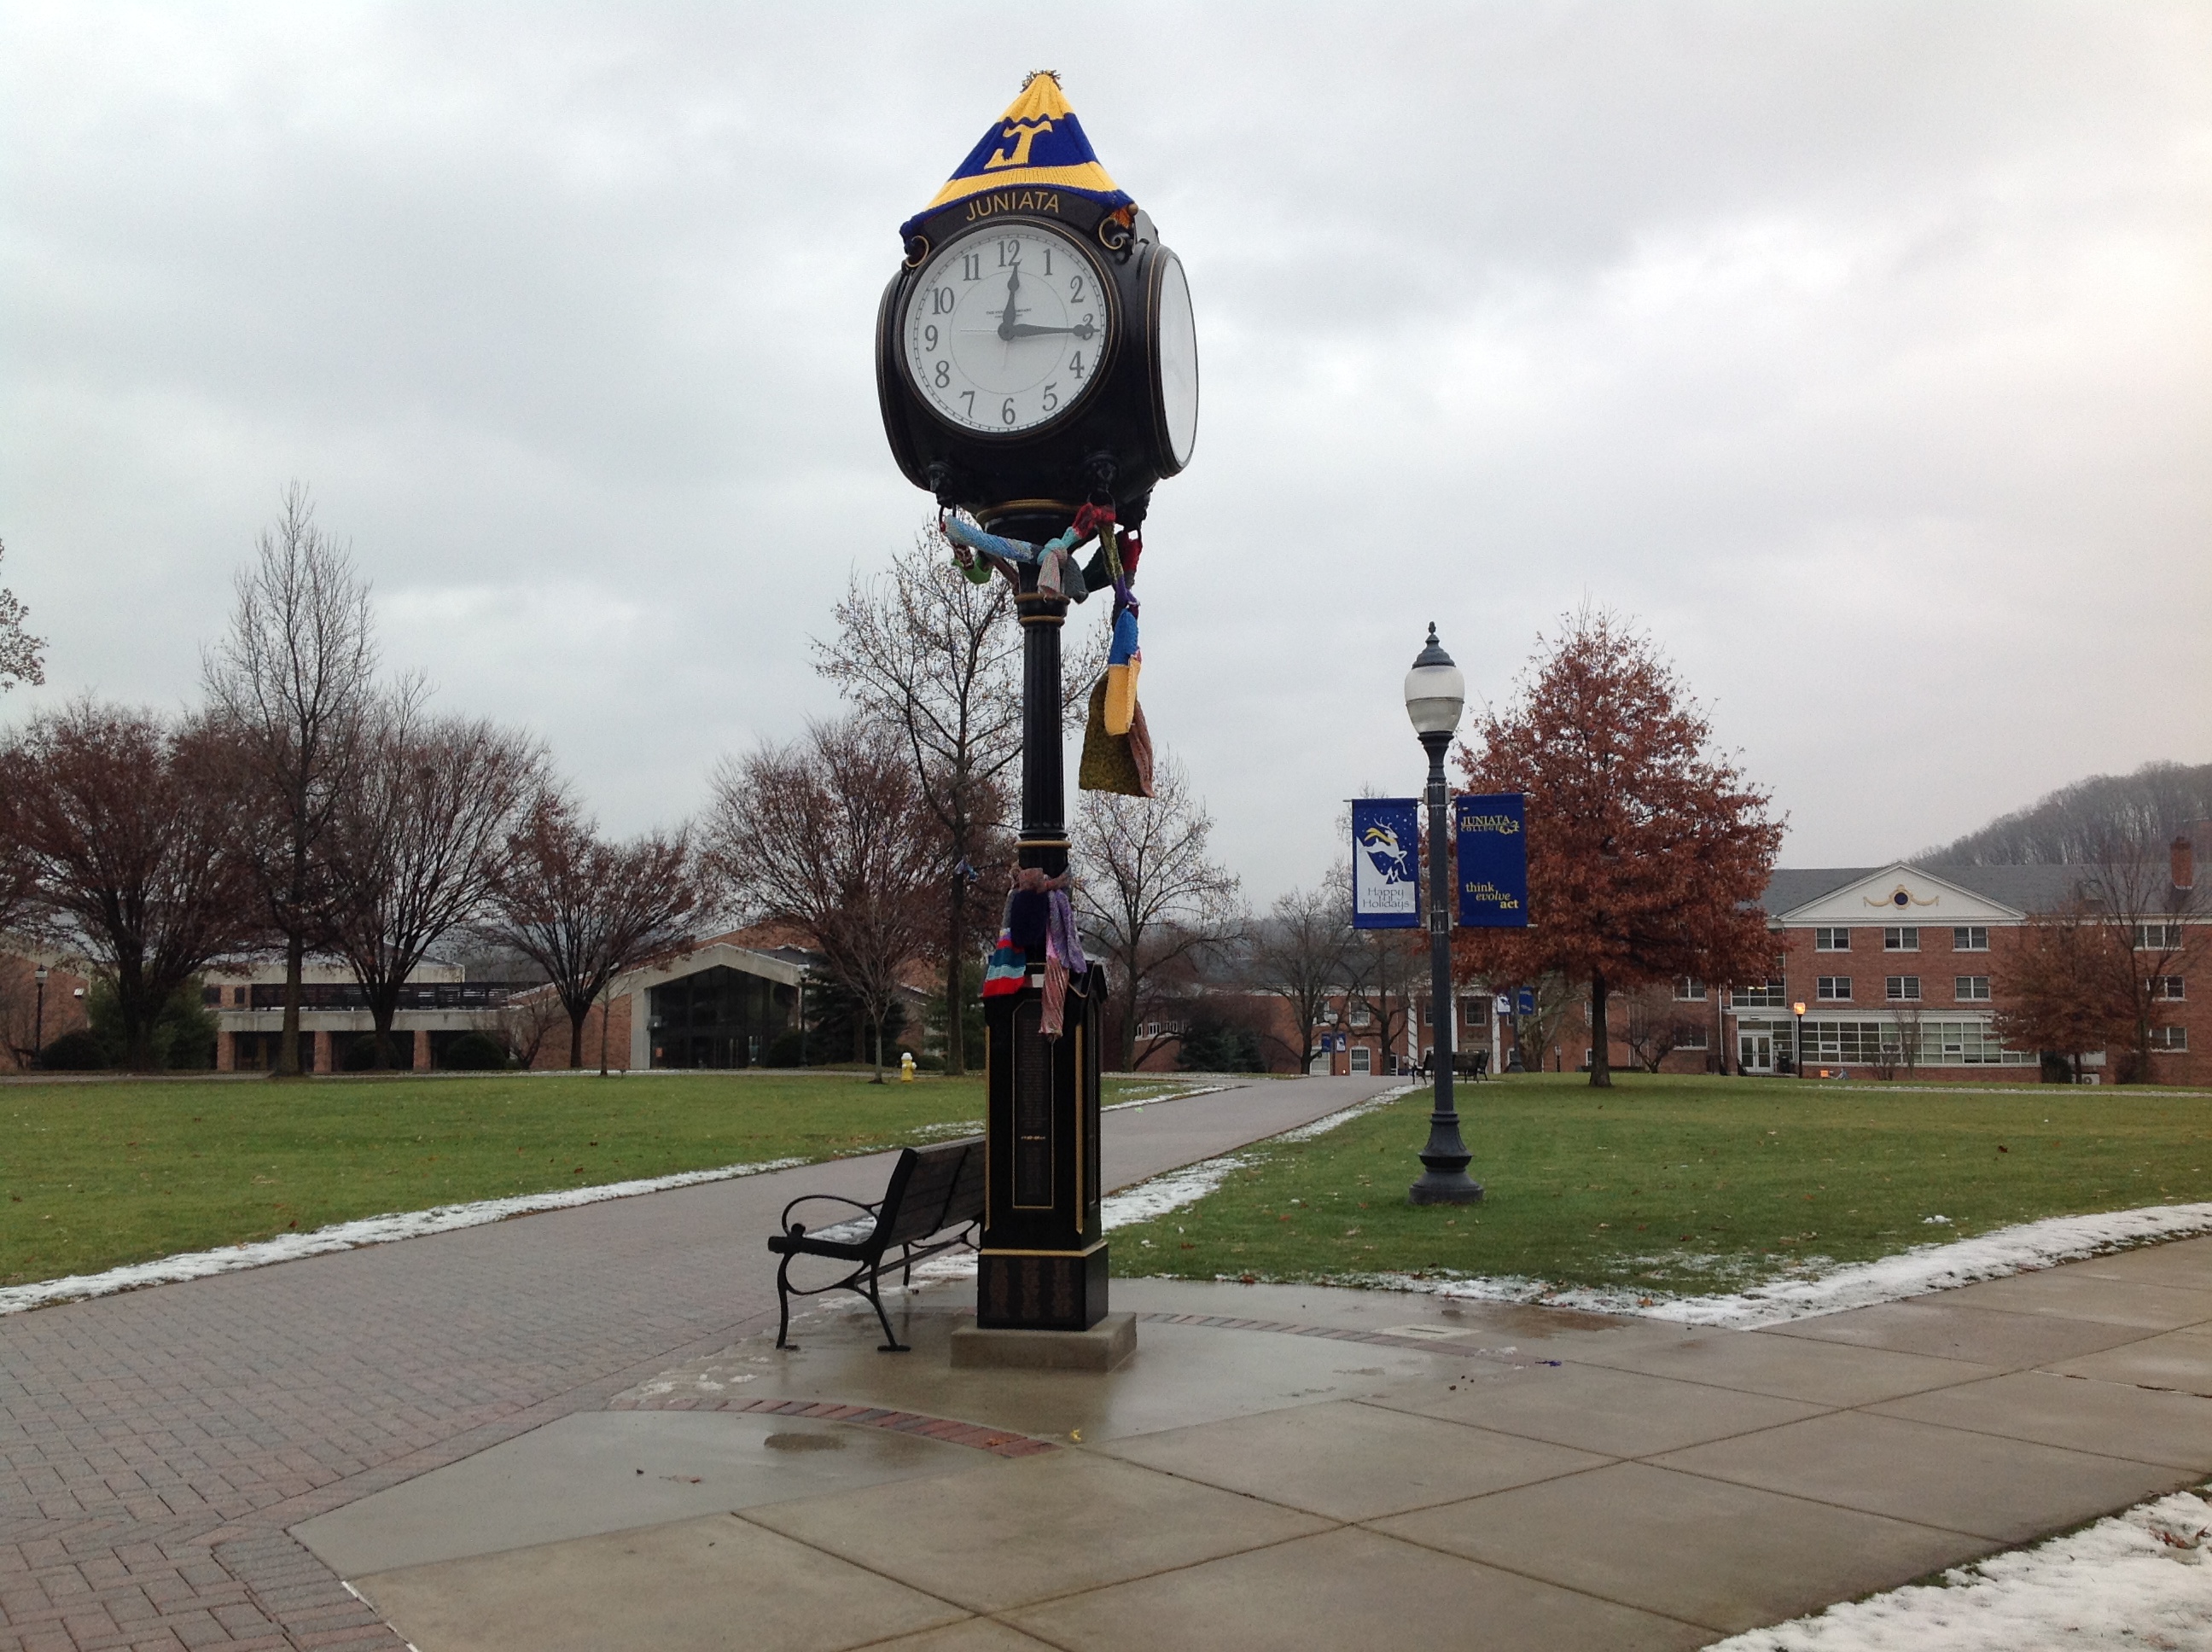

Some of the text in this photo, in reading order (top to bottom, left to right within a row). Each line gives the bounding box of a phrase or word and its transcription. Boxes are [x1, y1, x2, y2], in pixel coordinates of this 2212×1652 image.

[966, 191, 1060, 221] JUNIATA
[997, 239, 1022, 266] 12
[1043, 248, 1053, 276] 1
[962, 253, 981, 281] 11
[932, 287, 955, 315] 10
[1070, 275, 1086, 303] 2
[924, 324, 939, 352] 9
[1081, 313, 1093, 340] 3
[934, 360, 950, 388] 8
[1068, 351, 1085, 379] 4
[959, 391, 975, 418] 7
[1042, 382, 1058, 411] 5
[1002, 397, 1016, 425] 6
[1461, 815, 1511, 826] JUNIATA
[1368, 887, 1404, 901] Happy
[1465, 881, 1495, 893] think
[1476, 890, 1511, 901] evolve
[1363, 895, 1410, 911] Holidays
[1499, 899, 1519, 909] act
